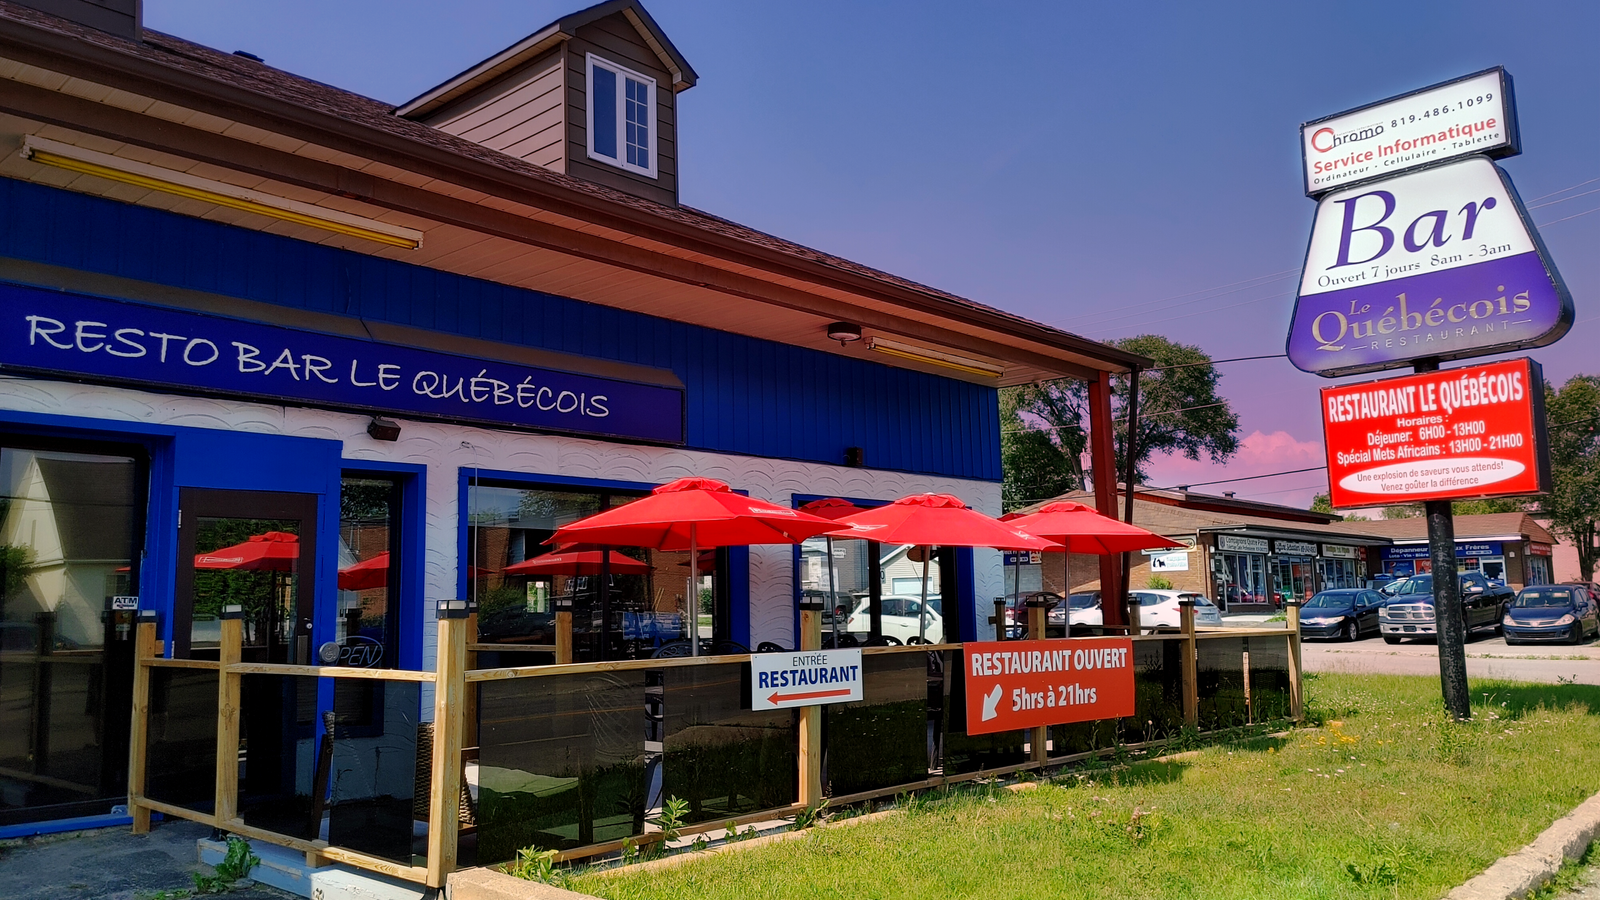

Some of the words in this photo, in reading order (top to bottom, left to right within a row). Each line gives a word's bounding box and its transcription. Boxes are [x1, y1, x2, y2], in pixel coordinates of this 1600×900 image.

[1311, 125, 1385, 154] Chromo
[1391, 93, 1493, 128] 819.486.1099
[1313, 166, 1370, 185] Ordinateur
[1383, 149, 1437, 167] Cellulaire
[1451, 132, 1500, 149] Tablette
[1314, 148, 1374, 174] Service
[1377, 117, 1497, 158] Informatique
[1325, 190, 1497, 270] Bar
[1317, 270, 1367, 288] Ouvert
[1371, 265, 1380, 278] 7
[1385, 261, 1421, 279] jours
[1430, 254, 1463, 267] 8am
[1478, 244, 1512, 257] 3am
[1312, 285, 1531, 352] Québécois
[1348, 299, 1371, 316] Le
[1371, 319, 1509, 350] RESTAURANT
[26, 315, 220, 366] RESTO
[231, 341, 339, 384] BAR
[350, 359, 401, 391] LE
[412, 368, 610, 417] QUÉBÉCOIS
[1328, 385, 1416, 423] RESTAURANT
[1419, 382, 1438, 412] LE
[1440, 371, 1524, 414] QUÉBÉCOIS
[1367, 430, 1413, 448] Déjeuner:
[1419, 425, 1445, 441] 6H00
[1453, 420, 1485, 437] 13H00
[1397, 415, 1443, 428] Horaires
[1337, 447, 1372, 467] Spécial
[1373, 447, 1396, 462] Mets
[1397, 442, 1441, 459] Africains
[1449, 437, 1481, 454] 13H00
[1489, 433, 1523, 450] 21H00
[1357, 472, 1372, 483] Une
[1373, 468, 1408, 485] explosion
[1409, 468, 1419, 478] de
[1420, 466, 1450, 477] saveurs
[1451, 465, 1471, 474] vous
[1471, 461, 1504, 473] attends!
[1381, 481, 1403, 492] Venez
[1404, 479, 1429, 493] goûter
[1430, 478, 1437, 488] la
[1439, 476, 1479, 488] différence
[1390, 547, 1429, 555] Dépanneur
[792, 653, 828, 667] ENTRÉE
[971, 648, 1072, 677] RESTAURANT
[1074, 647, 1128, 670] OUVERT
[758, 665, 859, 690] RESTAURANT
[1012, 688, 1044, 712] 5hrs
[1047, 689, 1055, 708] à
[1058, 684, 1097, 707] 21hrs
